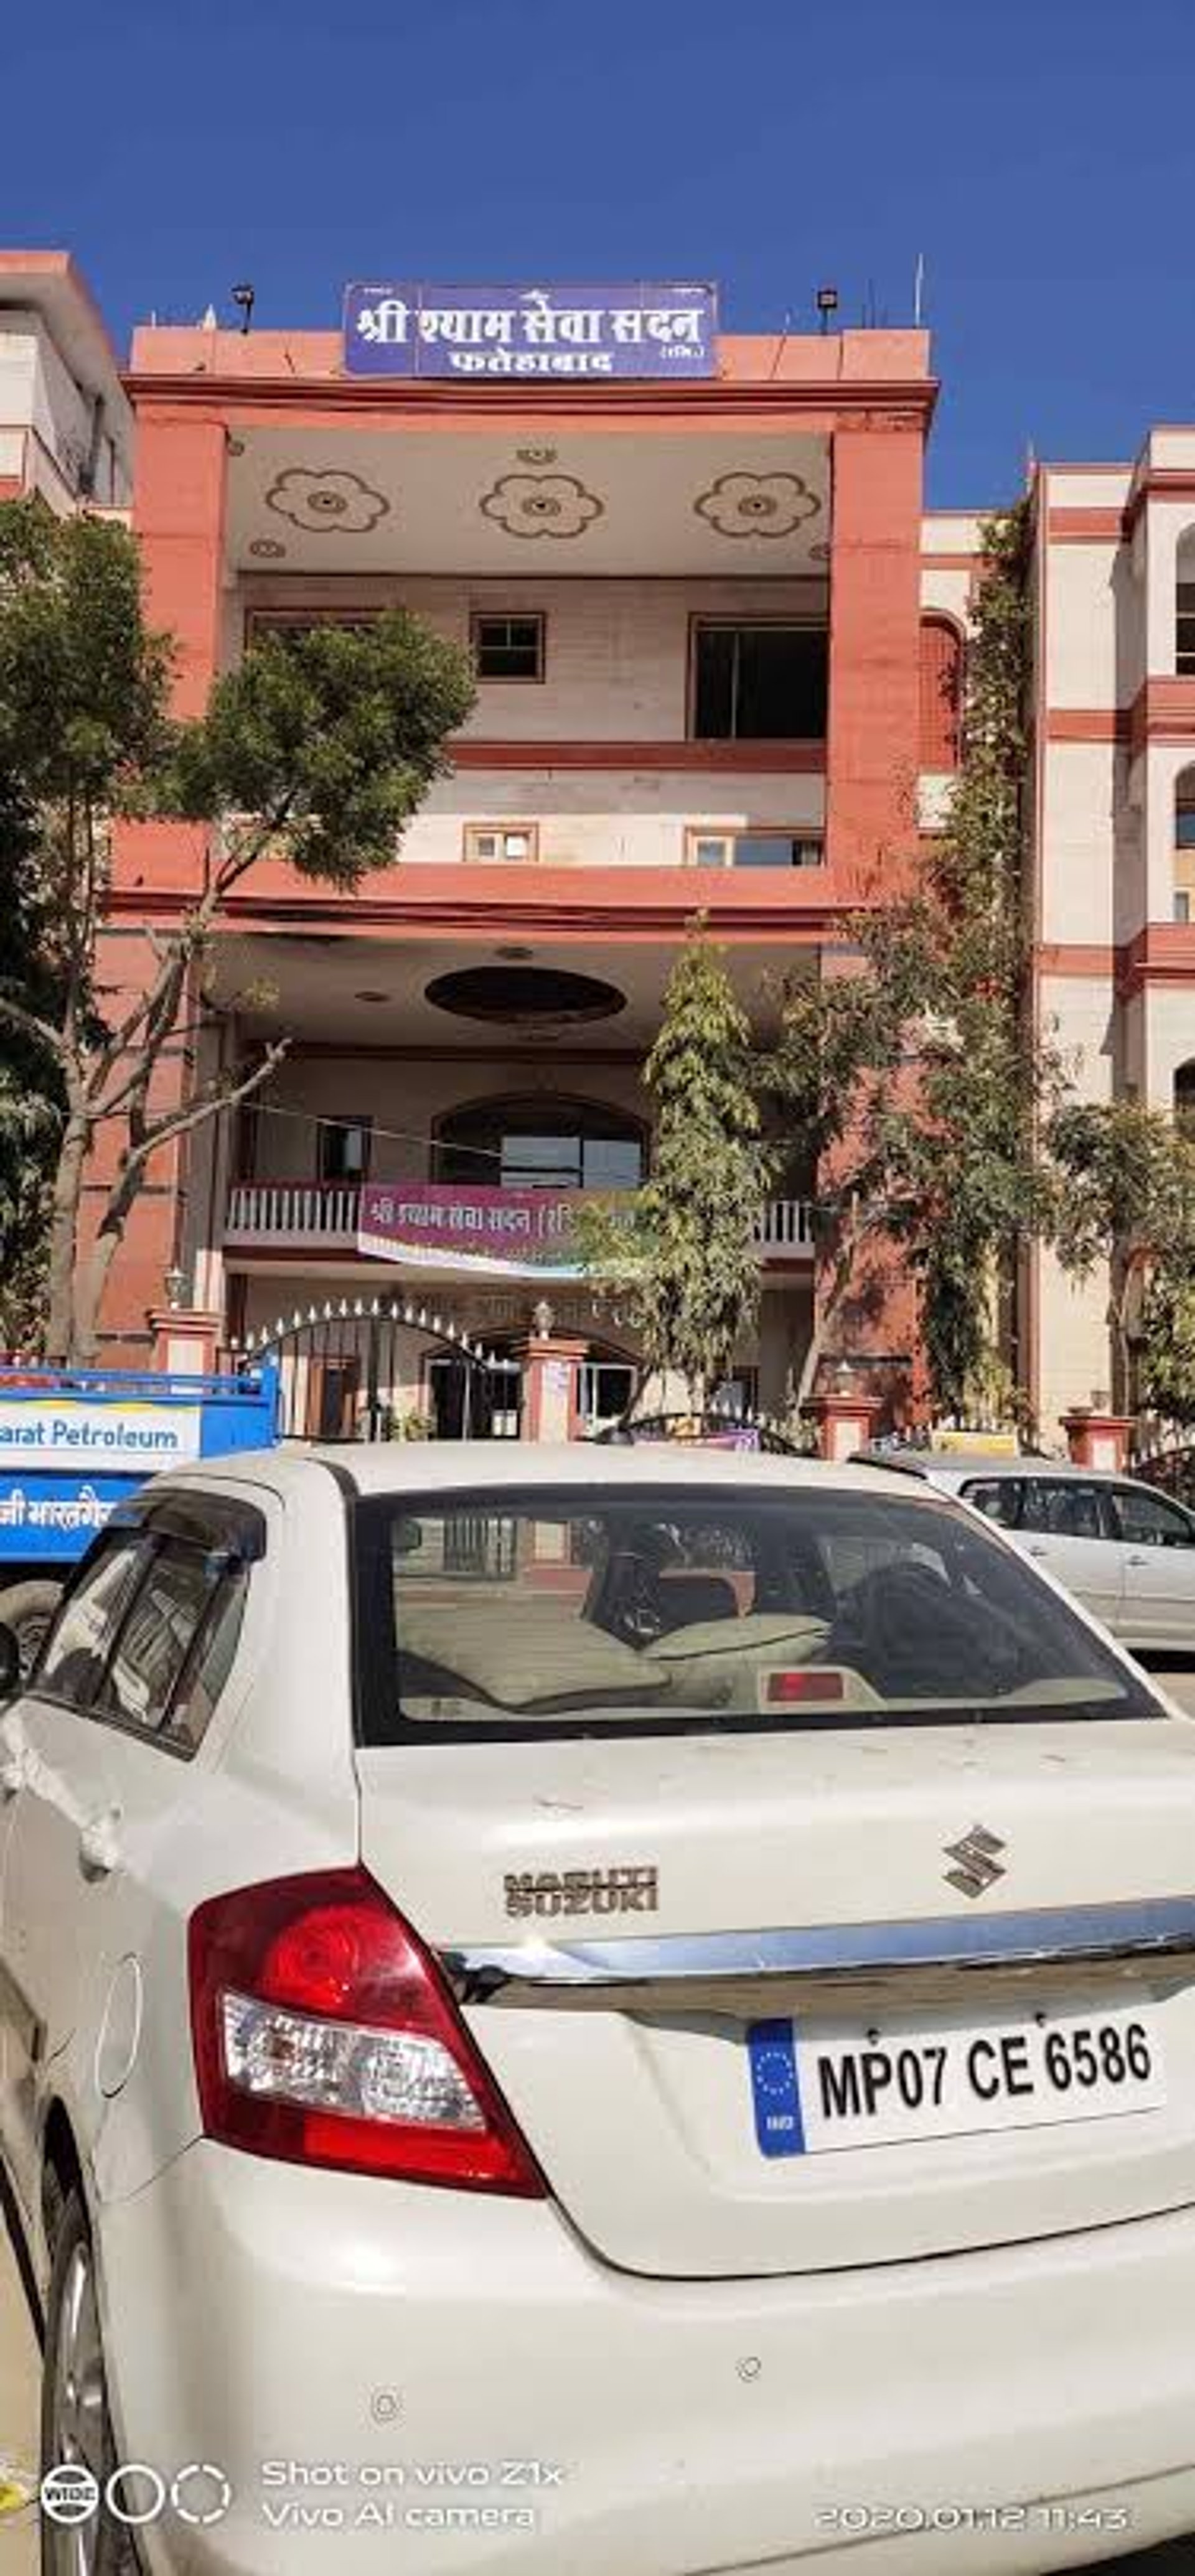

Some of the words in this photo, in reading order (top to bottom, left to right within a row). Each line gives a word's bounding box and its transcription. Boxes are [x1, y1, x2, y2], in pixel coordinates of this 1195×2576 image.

[357, 300, 410, 342] श्री
[415, 309, 516, 342] श्याम
[520, 300, 606, 342] सेवा
[608, 309, 705, 342] सदन
[448, 347, 615, 371] फतेहाबाद
[370, 1197, 394, 1224] श्री
[488, 1206, 530, 1233] सदन
[52, 1419, 179, 1448] Petroleum
[503, 1866, 657, 1892] MARUTI
[505, 1887, 657, 1916] SUZUKI
[818, 2046, 947, 2119] MP07
[967, 2036, 1034, 2099] CE
[1045, 2023, 1151, 2091] 6586
